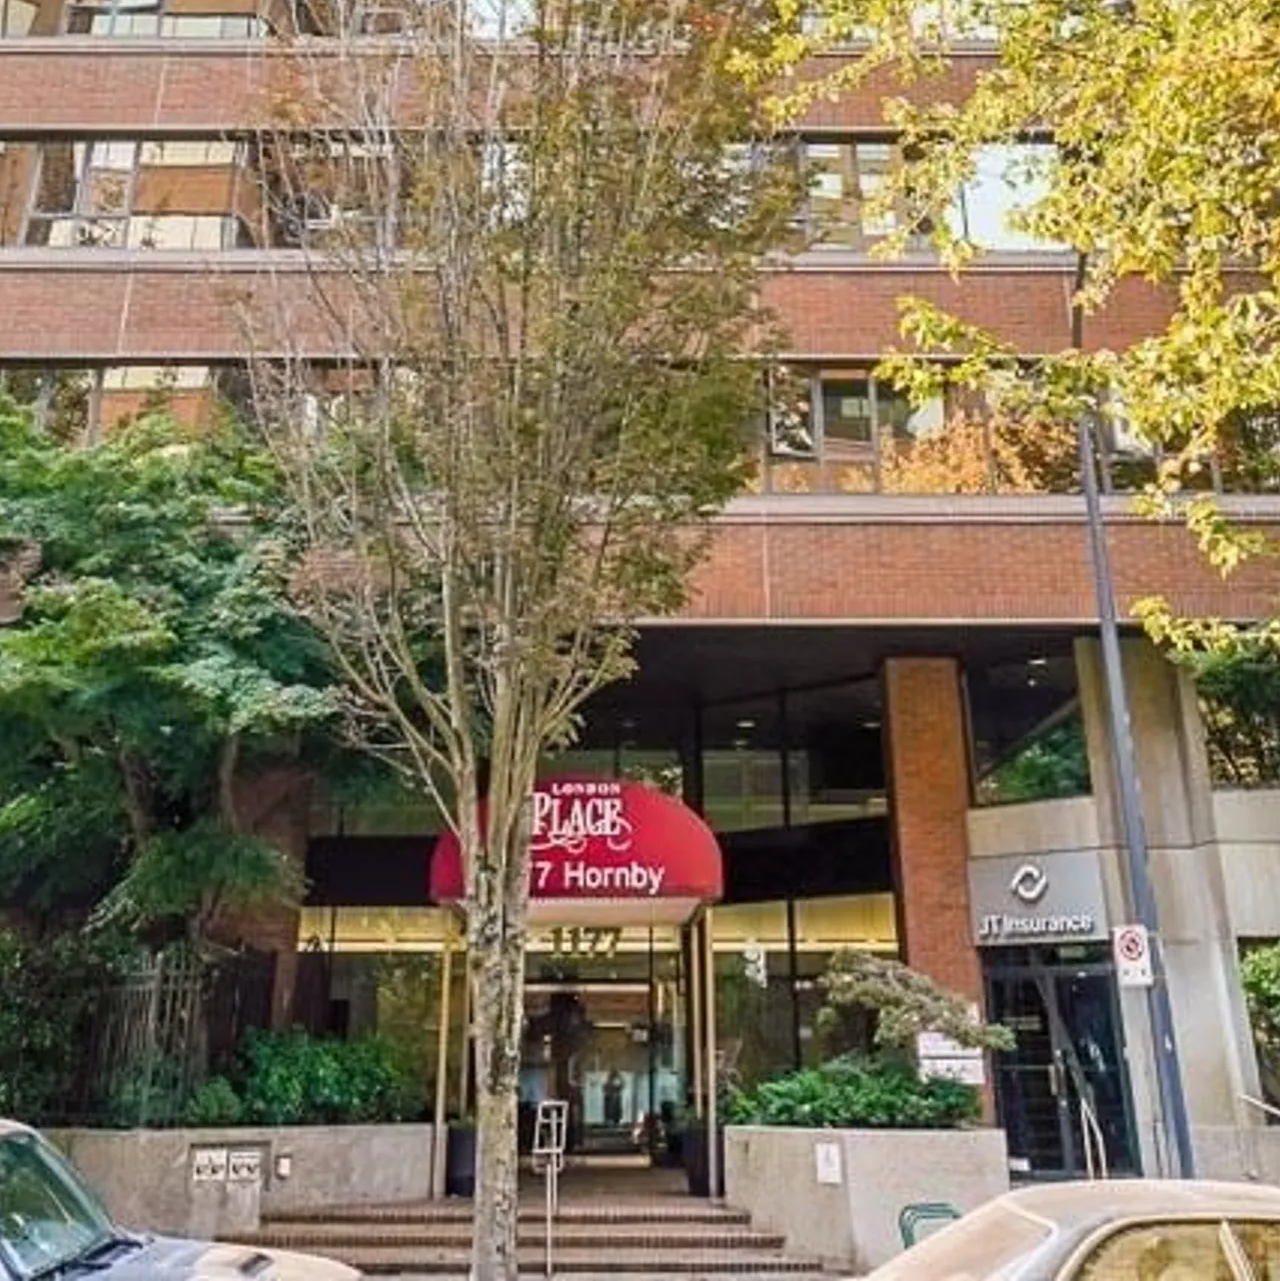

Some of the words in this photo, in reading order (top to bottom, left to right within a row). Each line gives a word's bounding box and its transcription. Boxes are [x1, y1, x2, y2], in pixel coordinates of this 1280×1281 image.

[552, 783, 620, 796] LONDON
[531, 792, 632, 841] PLACE
[564, 861, 665, 894] Hornby
[979, 914, 1003, 934] JT
[1003, 913, 1093, 933] Insurance
[549, 926, 622, 958] 1177
